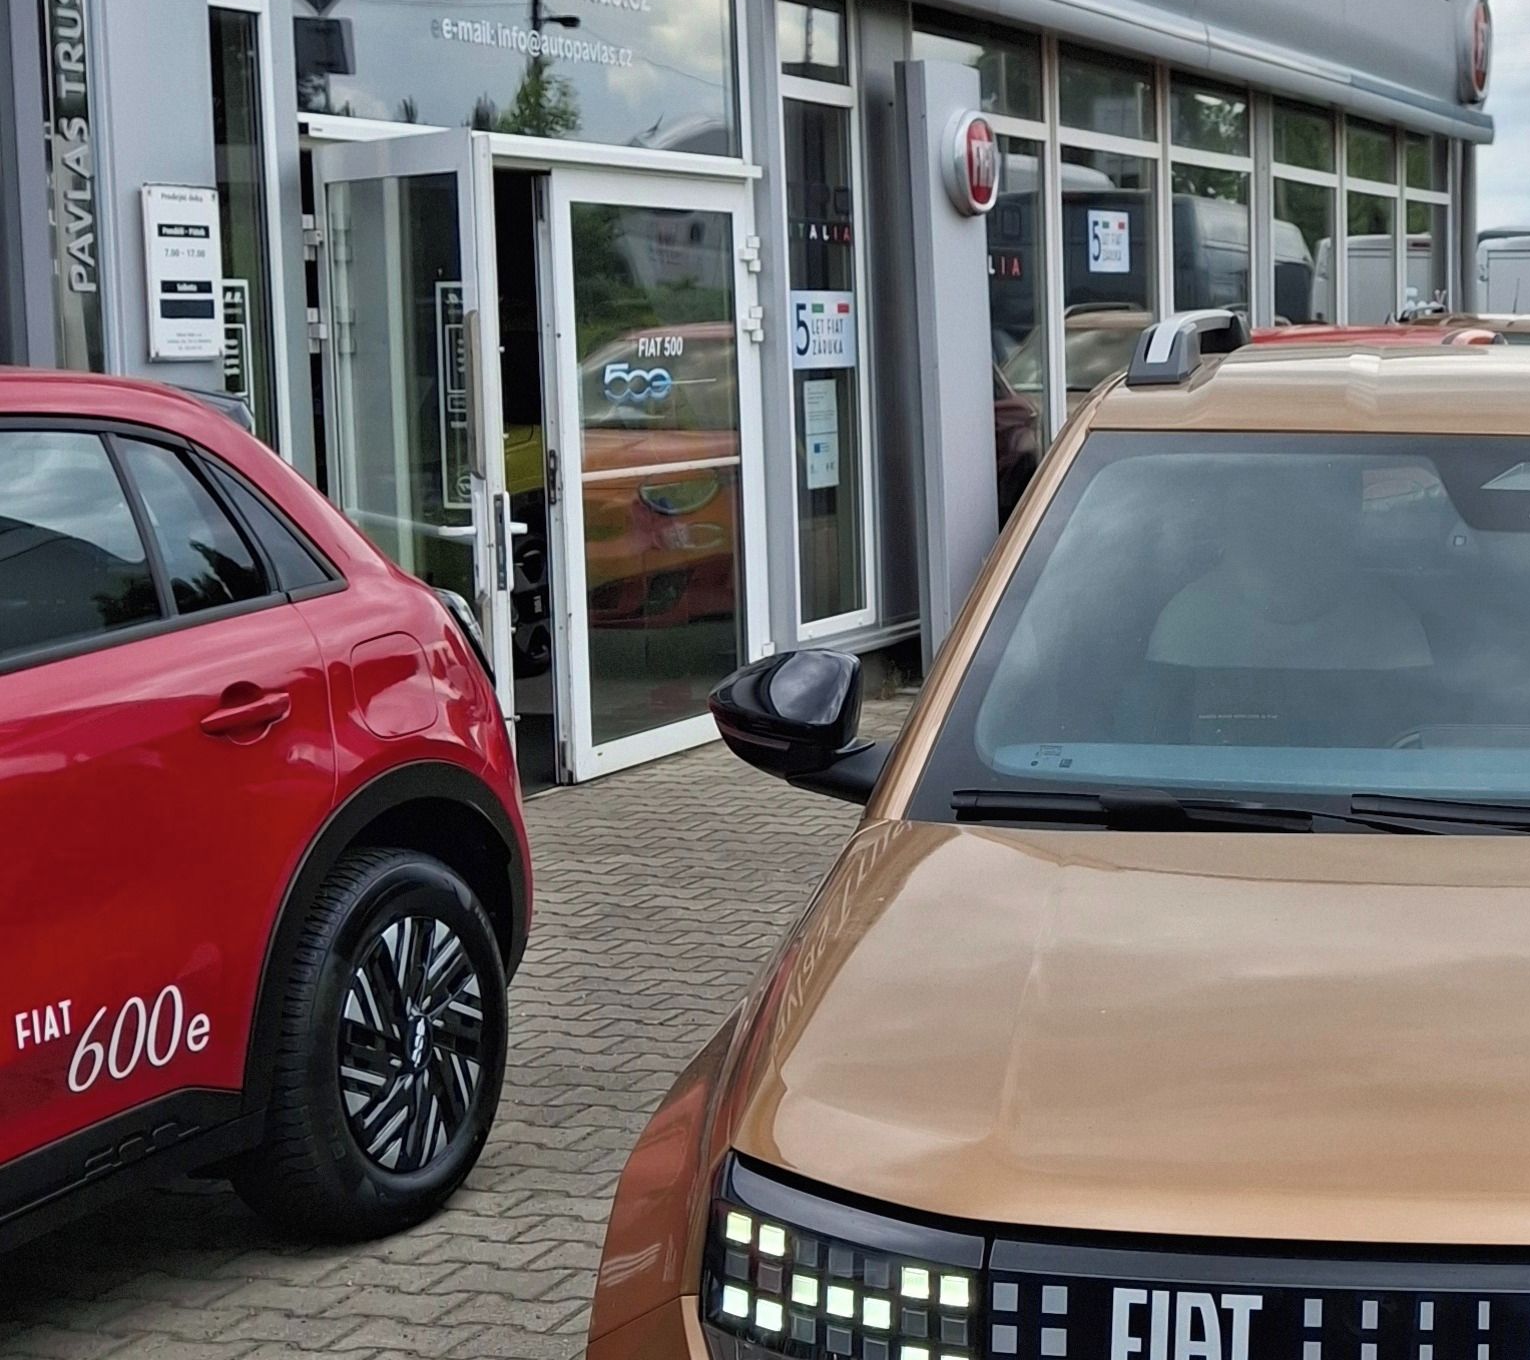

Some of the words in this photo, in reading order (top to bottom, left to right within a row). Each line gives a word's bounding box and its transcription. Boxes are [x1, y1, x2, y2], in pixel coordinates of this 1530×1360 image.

[441, 17, 495, 45] e-mail:
[497, 22, 633, 67] info@autopavlas.cz
[59, 116, 97, 293] PAVLAS
[1092, 220, 1101, 261] 5
[638, 337, 663, 358] FIAT
[663, 336, 684, 357] 500
[796, 303, 810, 357] 5
[827, 318, 843, 335] FIAT
[15, 999, 72, 1050] FIAT
[68, 984, 211, 1093] 600e
